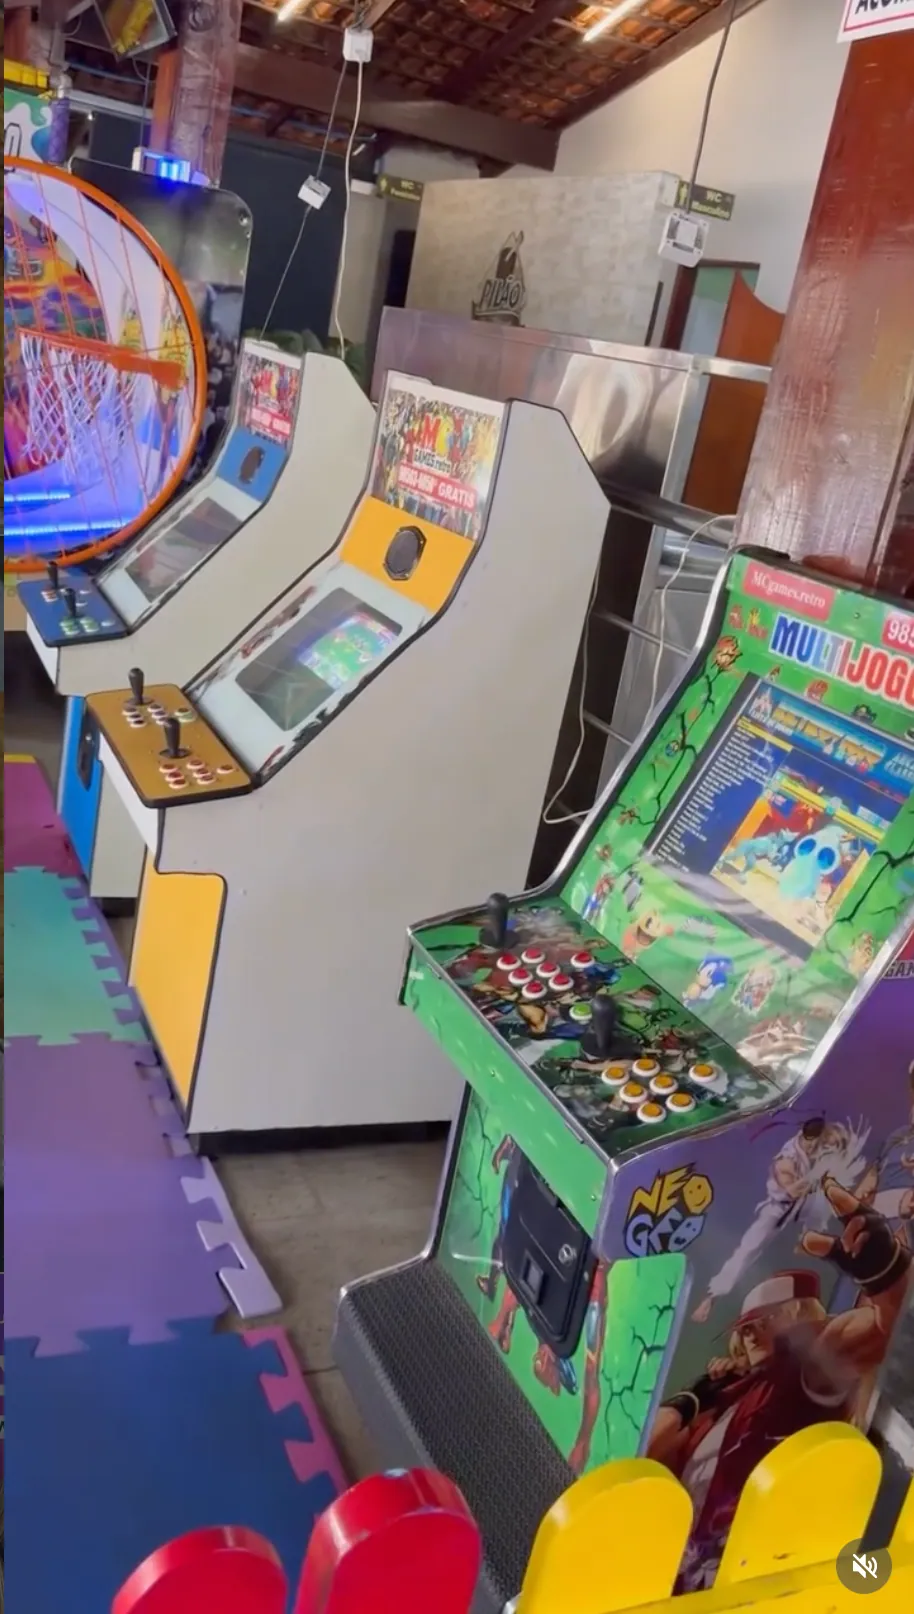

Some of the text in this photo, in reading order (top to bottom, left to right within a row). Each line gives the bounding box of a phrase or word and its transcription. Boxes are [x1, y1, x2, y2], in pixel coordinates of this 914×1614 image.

[706, 190, 722, 203] WC
[437, 481, 475, 509] GRATIS
[751, 570, 827, 609] MCgames.retro
[626, 1162, 714, 1220] NEO
[623, 1207, 707, 1257] GEO
